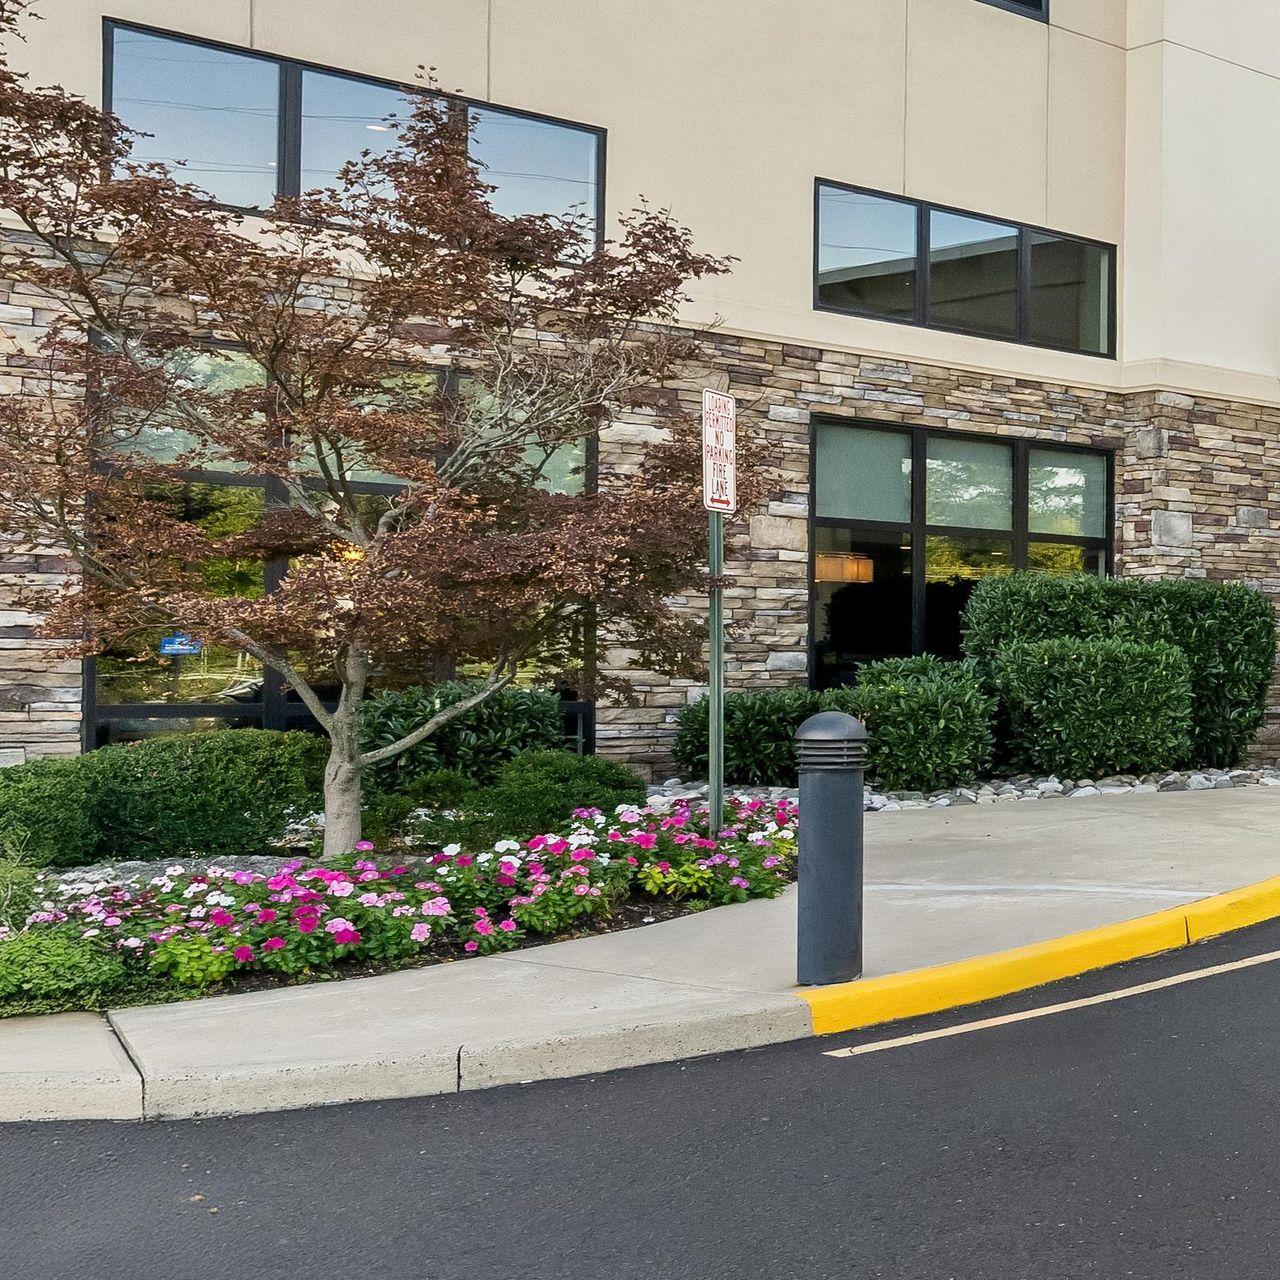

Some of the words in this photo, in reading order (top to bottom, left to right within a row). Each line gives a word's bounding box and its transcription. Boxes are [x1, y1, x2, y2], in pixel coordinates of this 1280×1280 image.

[708, 394, 730, 416] LOADING
[715, 430, 724, 447] NO
[705, 444, 734, 466] PARKING
[712, 462, 727, 480] FIRE
[711, 478, 728, 497] LANE
